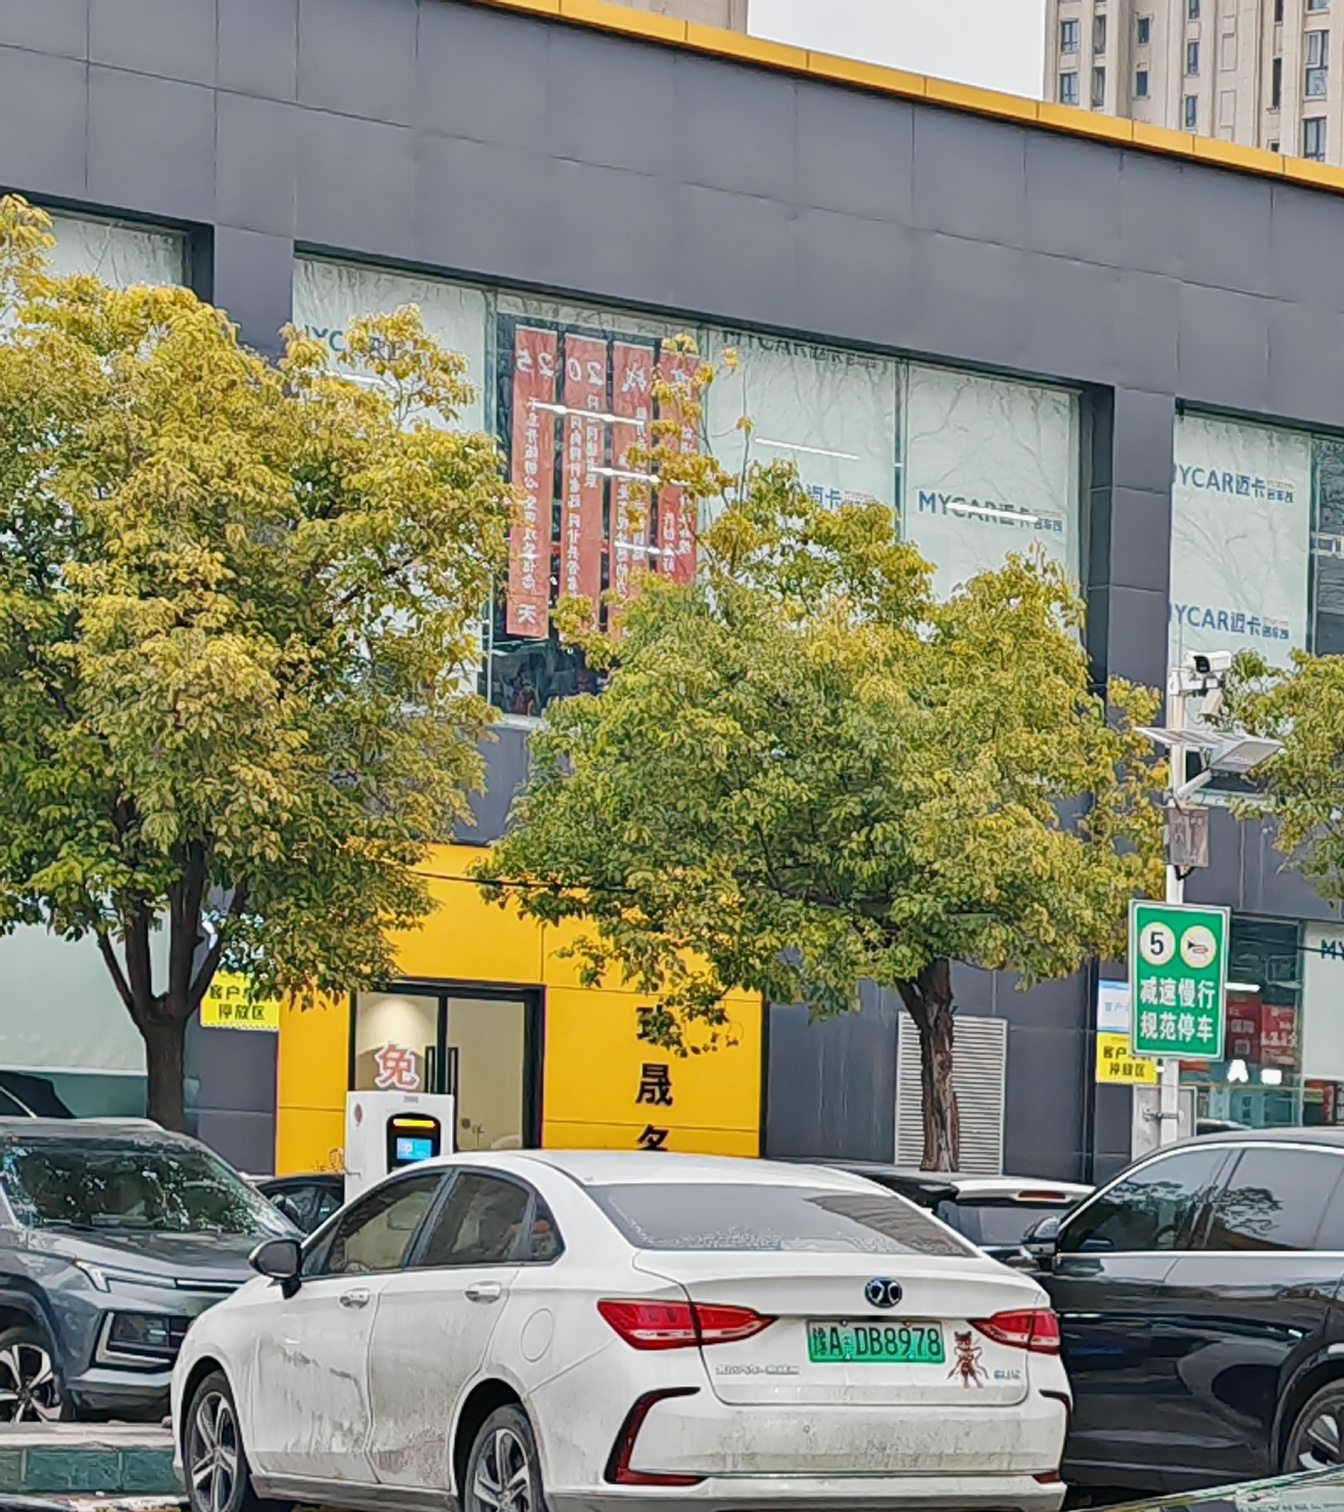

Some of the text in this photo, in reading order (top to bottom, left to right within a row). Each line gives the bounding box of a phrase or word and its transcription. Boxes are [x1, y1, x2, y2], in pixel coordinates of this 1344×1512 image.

[1150, 931, 1164, 955] 5
[1140, 976, 1216, 1010] 减速慢行
[1140, 1011, 1214, 1044] 规范停车
